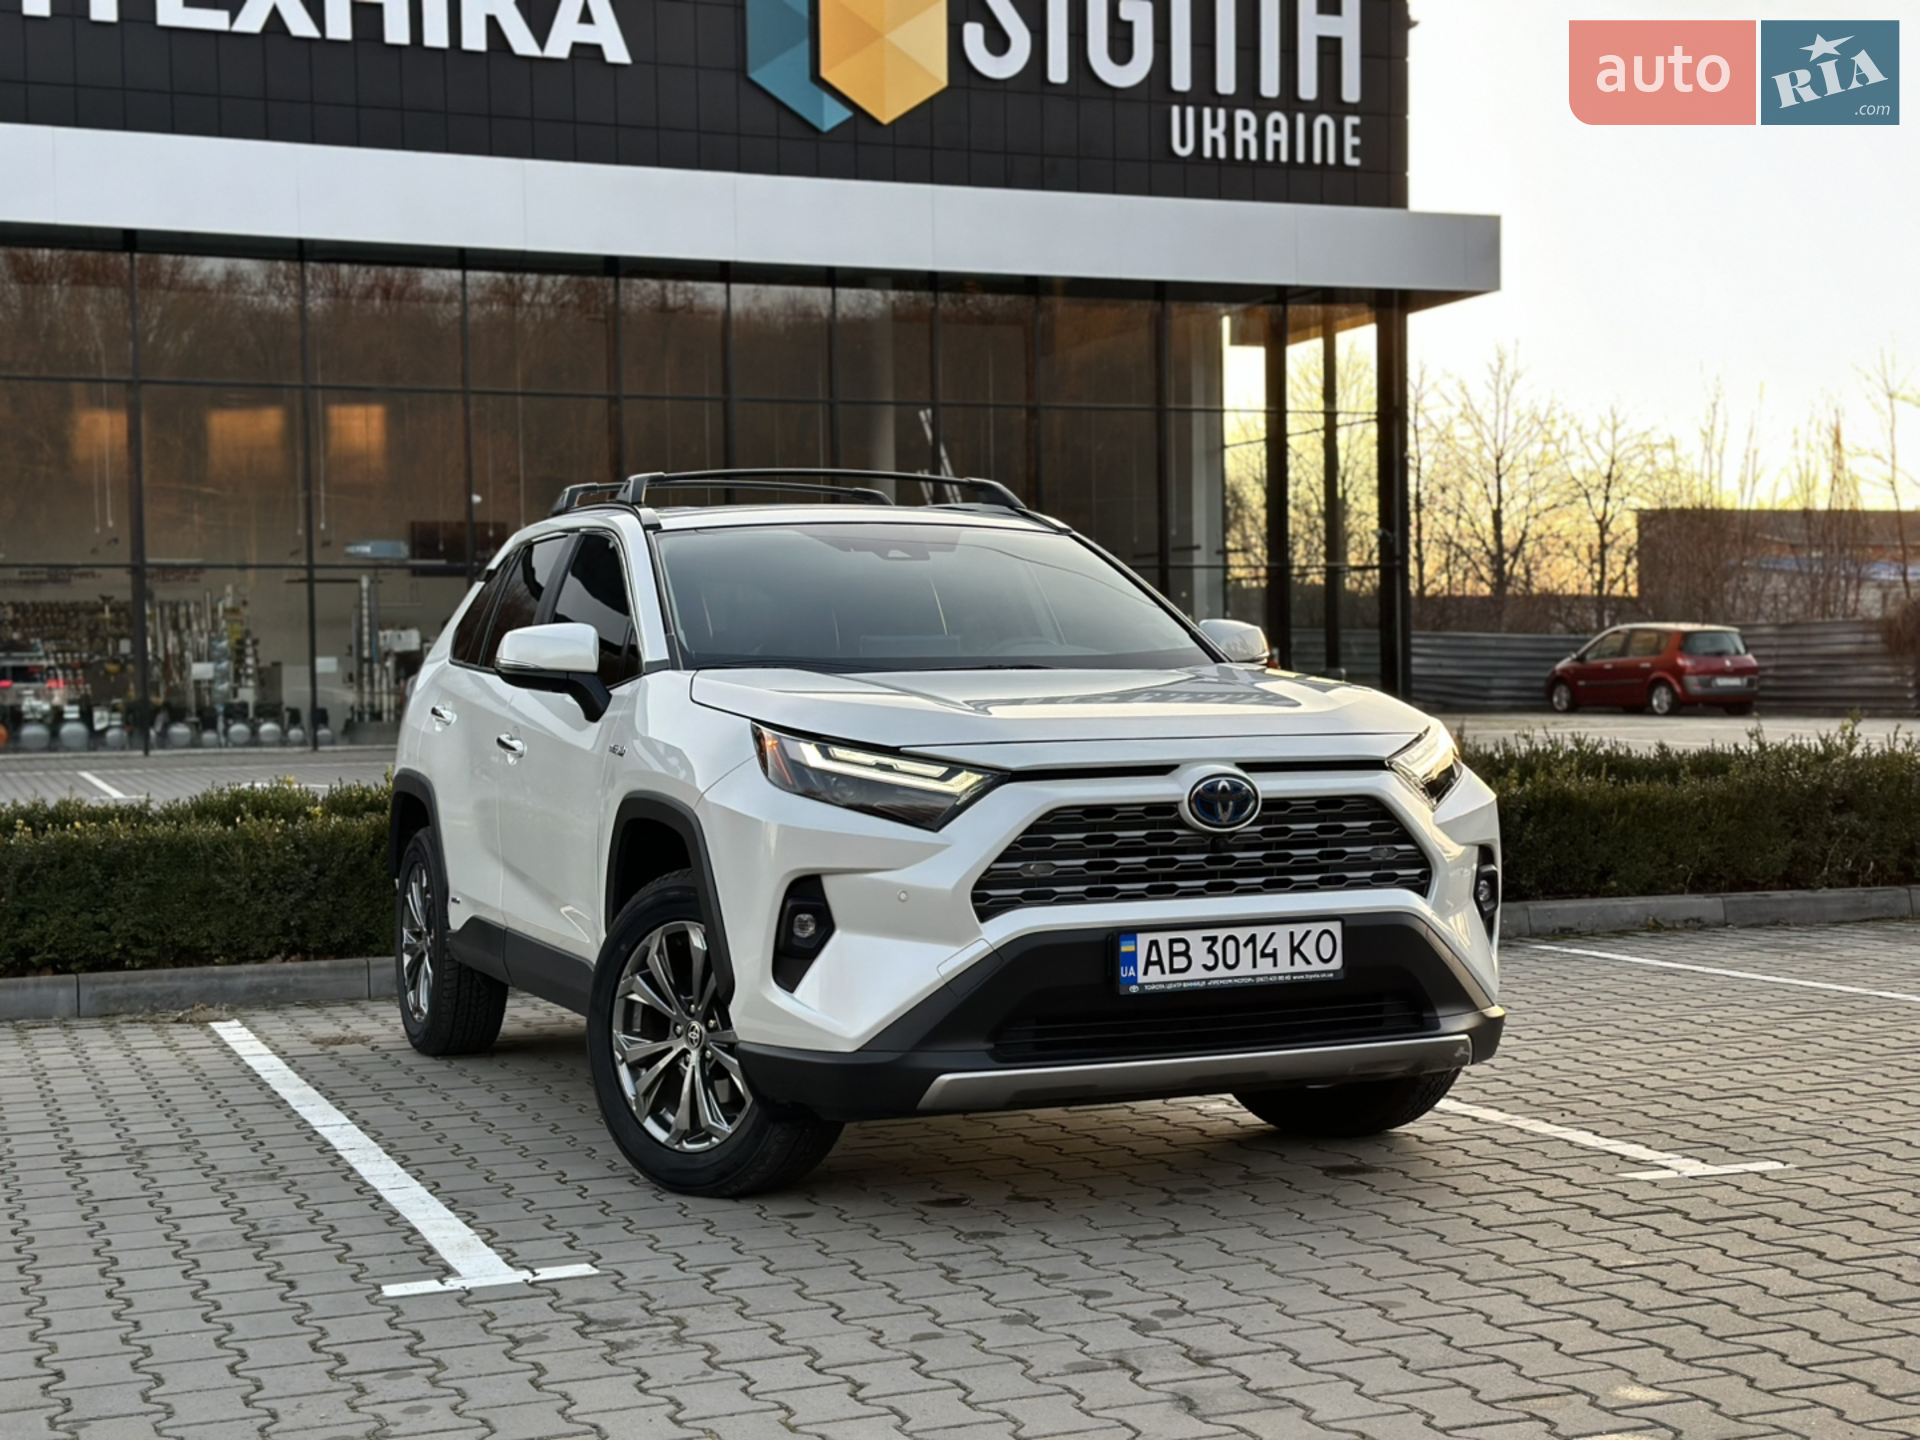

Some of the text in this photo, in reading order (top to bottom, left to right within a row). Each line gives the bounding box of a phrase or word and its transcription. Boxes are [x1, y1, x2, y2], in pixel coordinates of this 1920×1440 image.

[1171, 105, 1362, 166] UKRAINE
[1121, 967, 1136, 977] UA
[1142, 929, 1337, 976] AB 3014 KO
